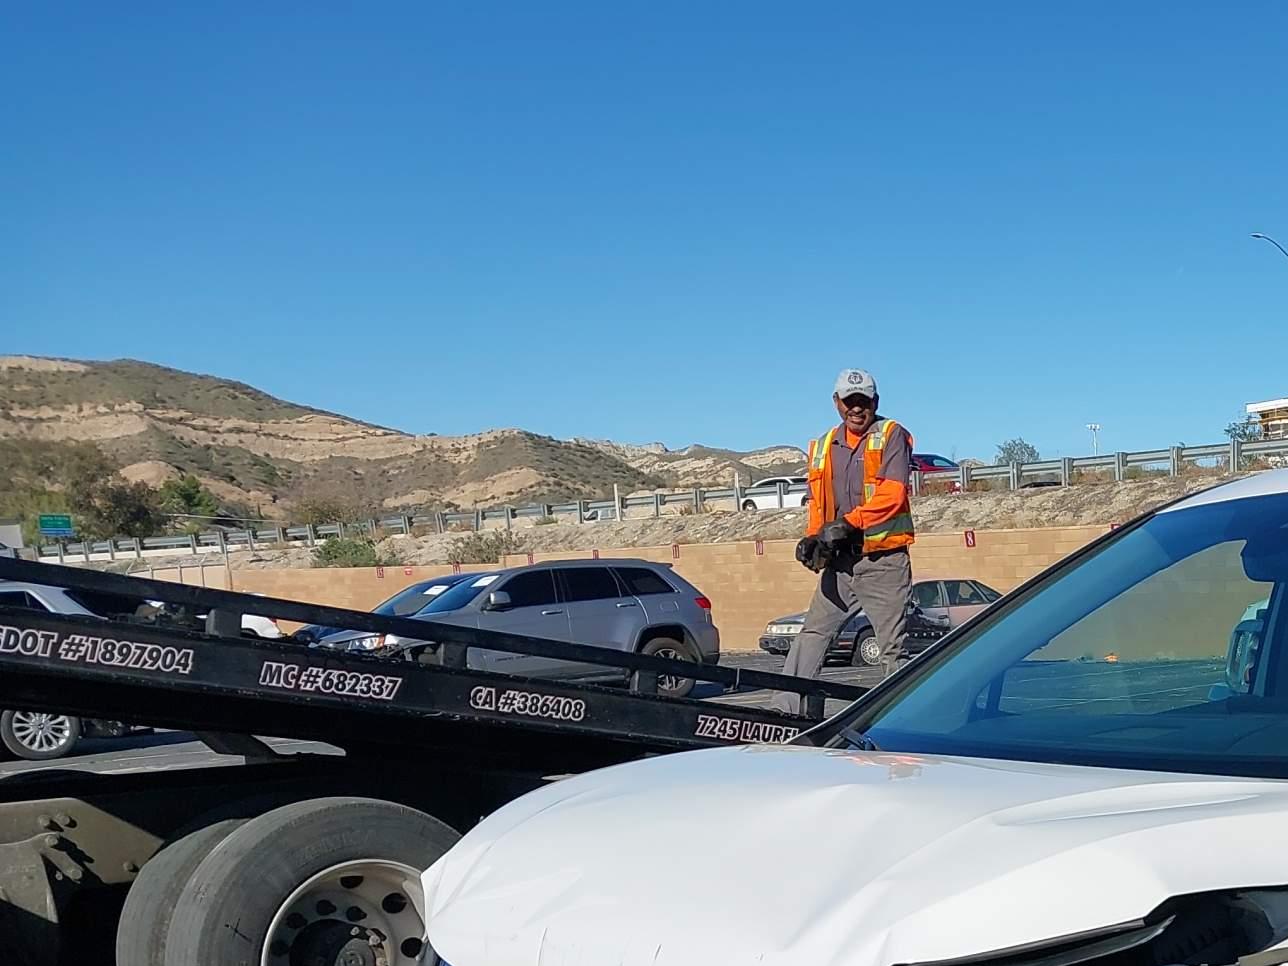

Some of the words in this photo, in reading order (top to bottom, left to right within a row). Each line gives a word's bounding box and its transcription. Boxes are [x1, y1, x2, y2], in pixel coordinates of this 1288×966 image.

[967, 532, 974, 546] 8
[0, 625, 58, 657] DOT
[59, 634, 194, 674] #1897904
[259, 661, 299, 688] MC
[299, 667, 402, 700] #682337
[470, 686, 496, 710] CA
[498, 690, 586, 722] #386408
[695, 714, 741, 740] 7245
